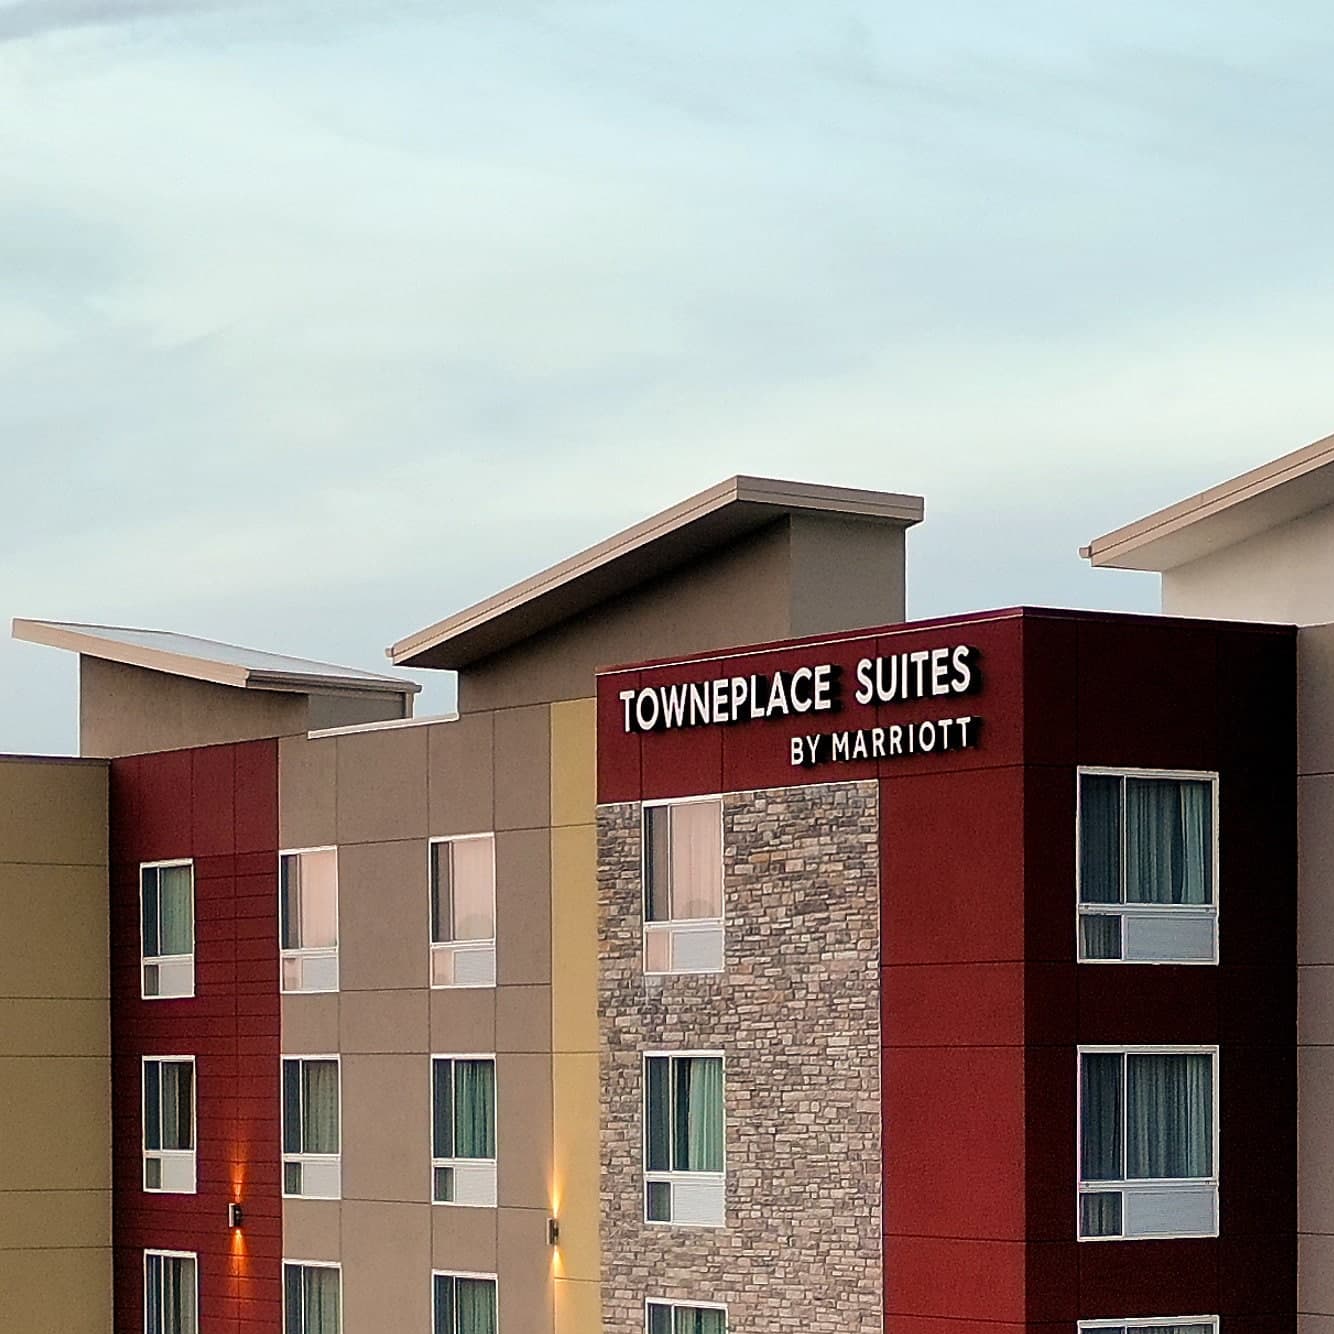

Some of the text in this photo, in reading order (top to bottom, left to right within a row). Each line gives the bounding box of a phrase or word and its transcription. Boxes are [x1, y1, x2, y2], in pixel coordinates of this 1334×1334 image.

[619, 645, 971, 733] TOWNEPLACE SUITES
[791, 716, 971, 765] BY MARRIOTT
